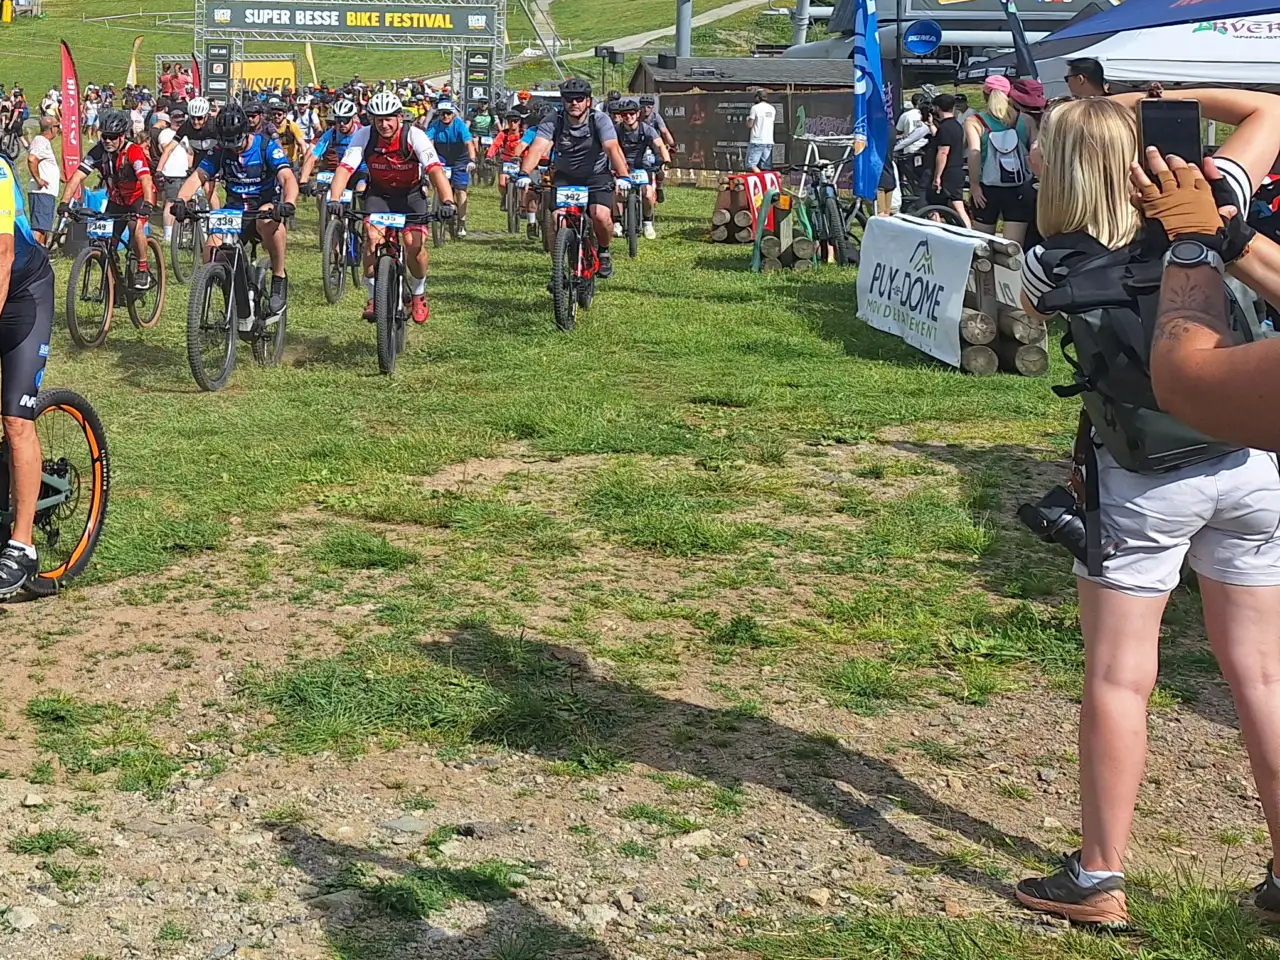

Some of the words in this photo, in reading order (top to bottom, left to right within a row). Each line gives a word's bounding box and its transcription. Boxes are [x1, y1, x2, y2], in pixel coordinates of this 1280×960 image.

[245, 9, 291, 25] SUPER
[295, 9, 339, 26] BESSE
[347, 11, 380, 27] BIKE
[384, 12, 453, 29] FESTIVAL
[665, 107, 674, 116] ON
[675, 107, 685, 116] AIR
[217, 217, 233, 226] 339
